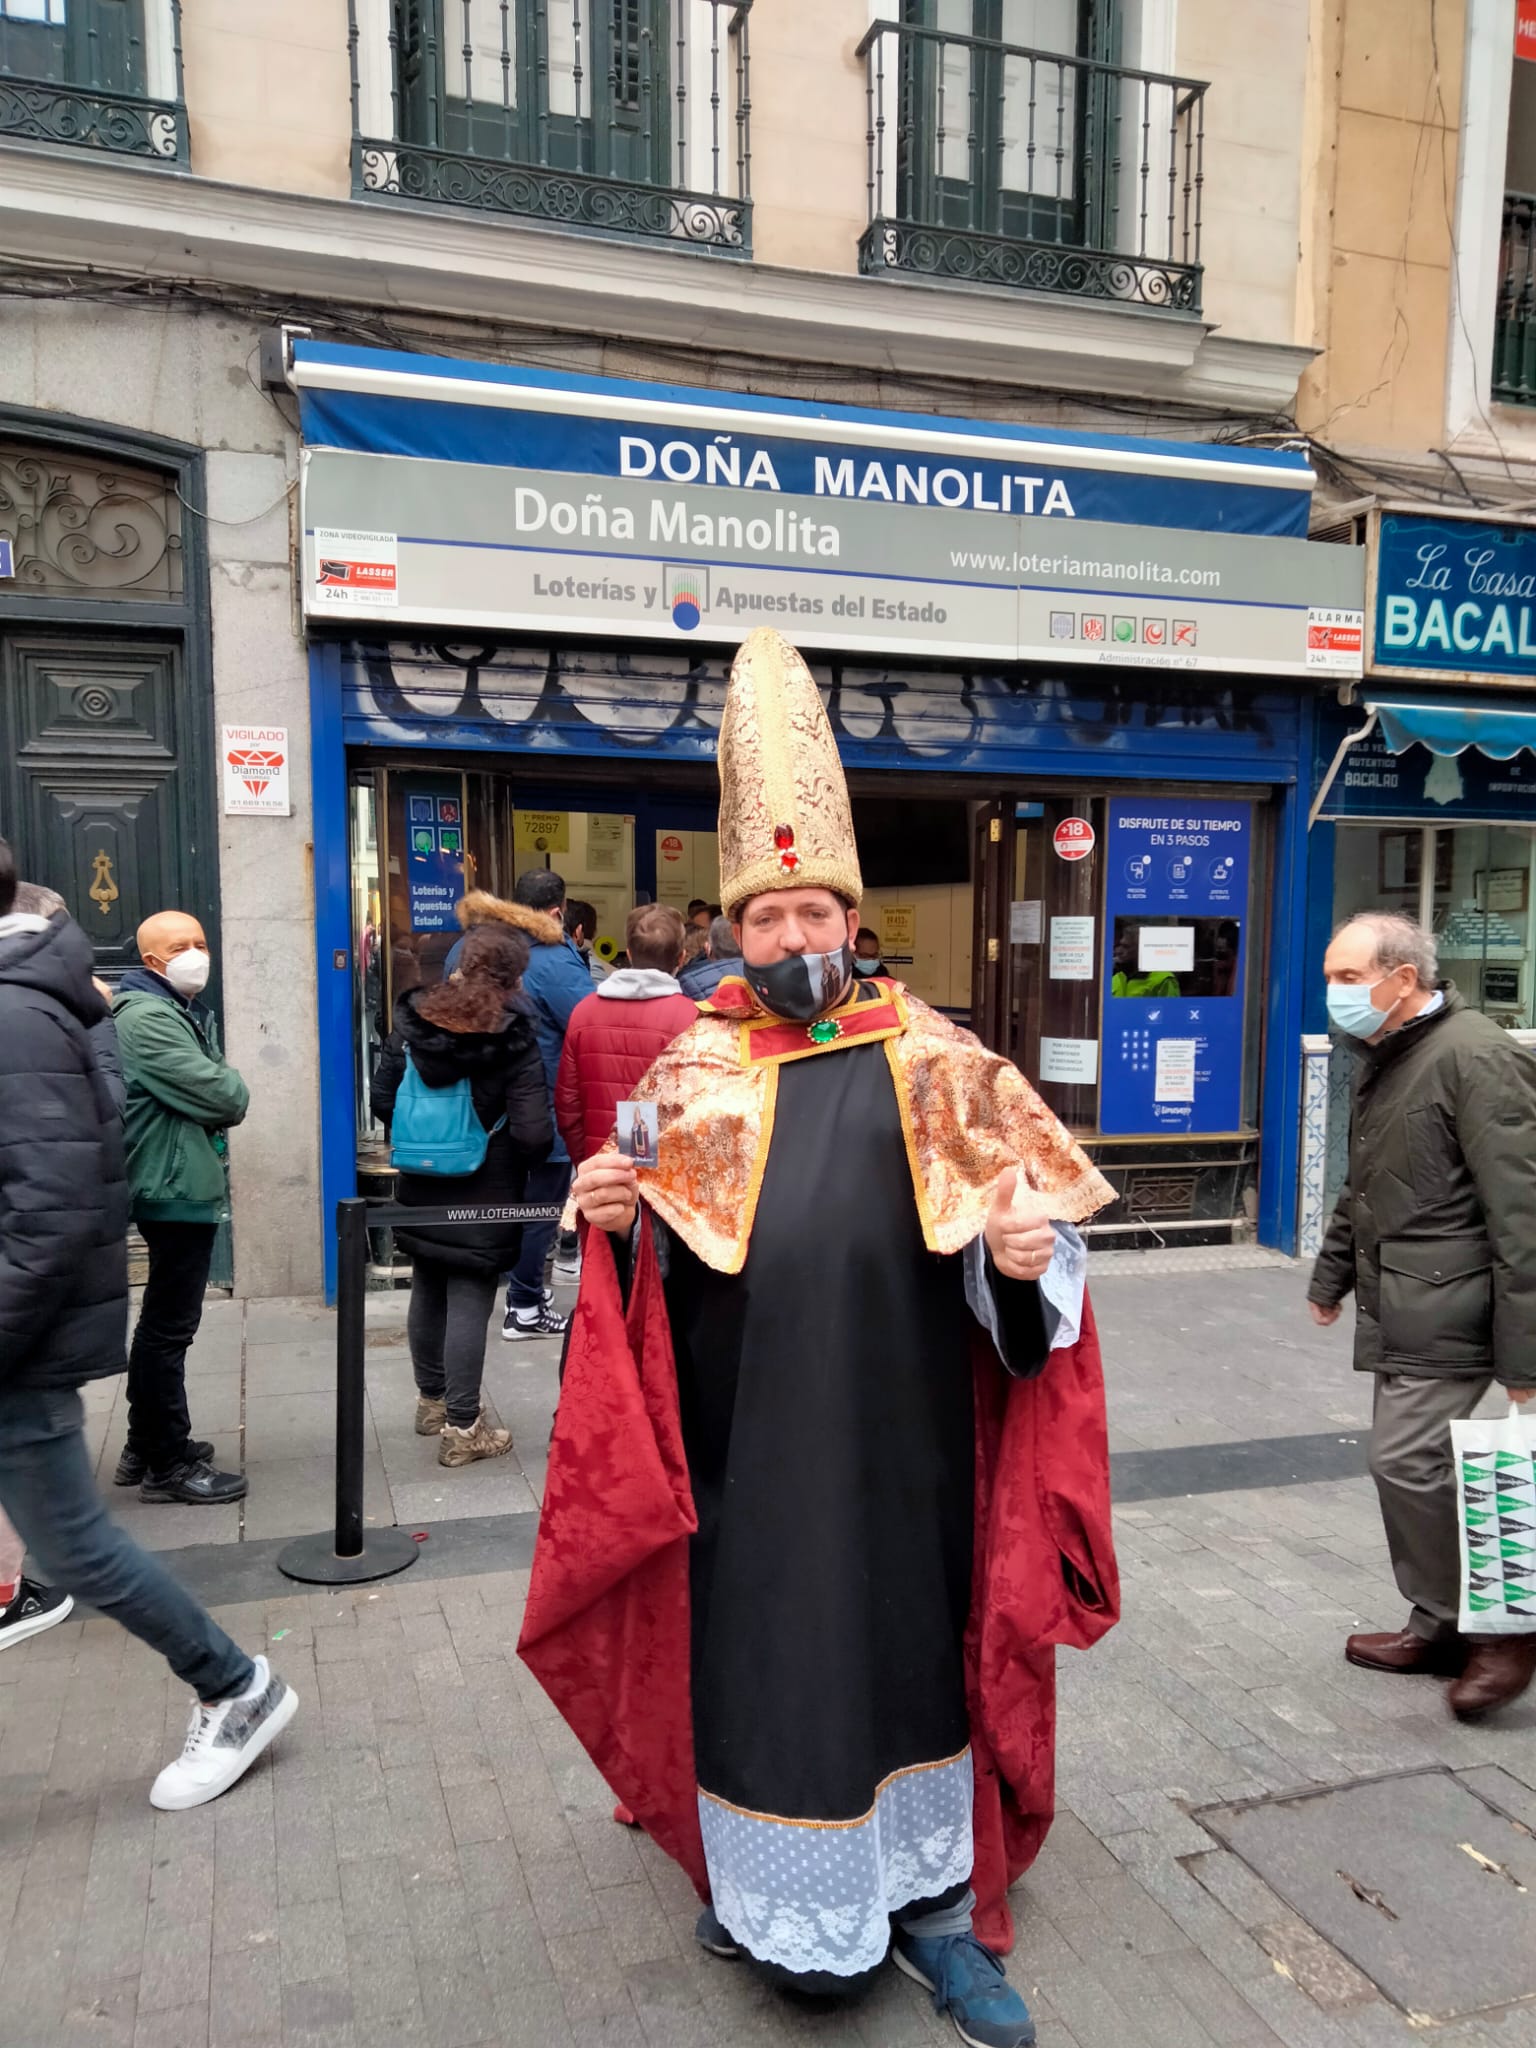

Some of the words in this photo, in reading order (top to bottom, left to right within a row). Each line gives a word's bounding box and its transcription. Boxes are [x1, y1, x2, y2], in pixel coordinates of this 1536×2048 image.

[618, 436, 781, 491] DOÑA
[814, 456, 1075, 518] MANOLITA
[514, 488, 635, 539] Doña
[649, 500, 840, 557] Manolita
[320, 530, 340, 539] ZONA
[341, 532, 394, 542] VIDEOVIGILADA
[356, 566, 394, 576] LASSER
[950, 548, 1221, 587] www.loteriamanolita.com
[1406, 543, 1452, 591] La
[1464, 548, 1536, 598] Casa
[325, 588, 349, 599] 24h
[533, 573, 636, 603] Loterías
[643, 587, 658, 608] y
[716, 586, 824, 618] Apuestas
[832, 595, 865, 619] del
[872, 599, 948, 625] Estado
[1309, 611, 1362, 625] ALARMA
[1383, 594, 1536, 656] BACAL
[1099, 652, 1170, 668] Administración
[226, 729, 285, 742] VIGILADO
[1344, 770, 1399, 788] BACALAO
[524, 821, 560, 834] 72897
[1061, 822, 1084, 836] +18
[1118, 817, 1169, 830] DISFRUTE
[1170, 818, 1185, 830] DE
[1186, 819, 1201, 831] SU
[1202, 819, 1241, 832] TIEMPO
[1151, 834, 1165, 846] EN
[1166, 834, 1174, 846] 3
[1175, 834, 1210, 847] PASOS
[413, 900, 453, 913] Apuestas
[414, 914, 444, 926] Estado
